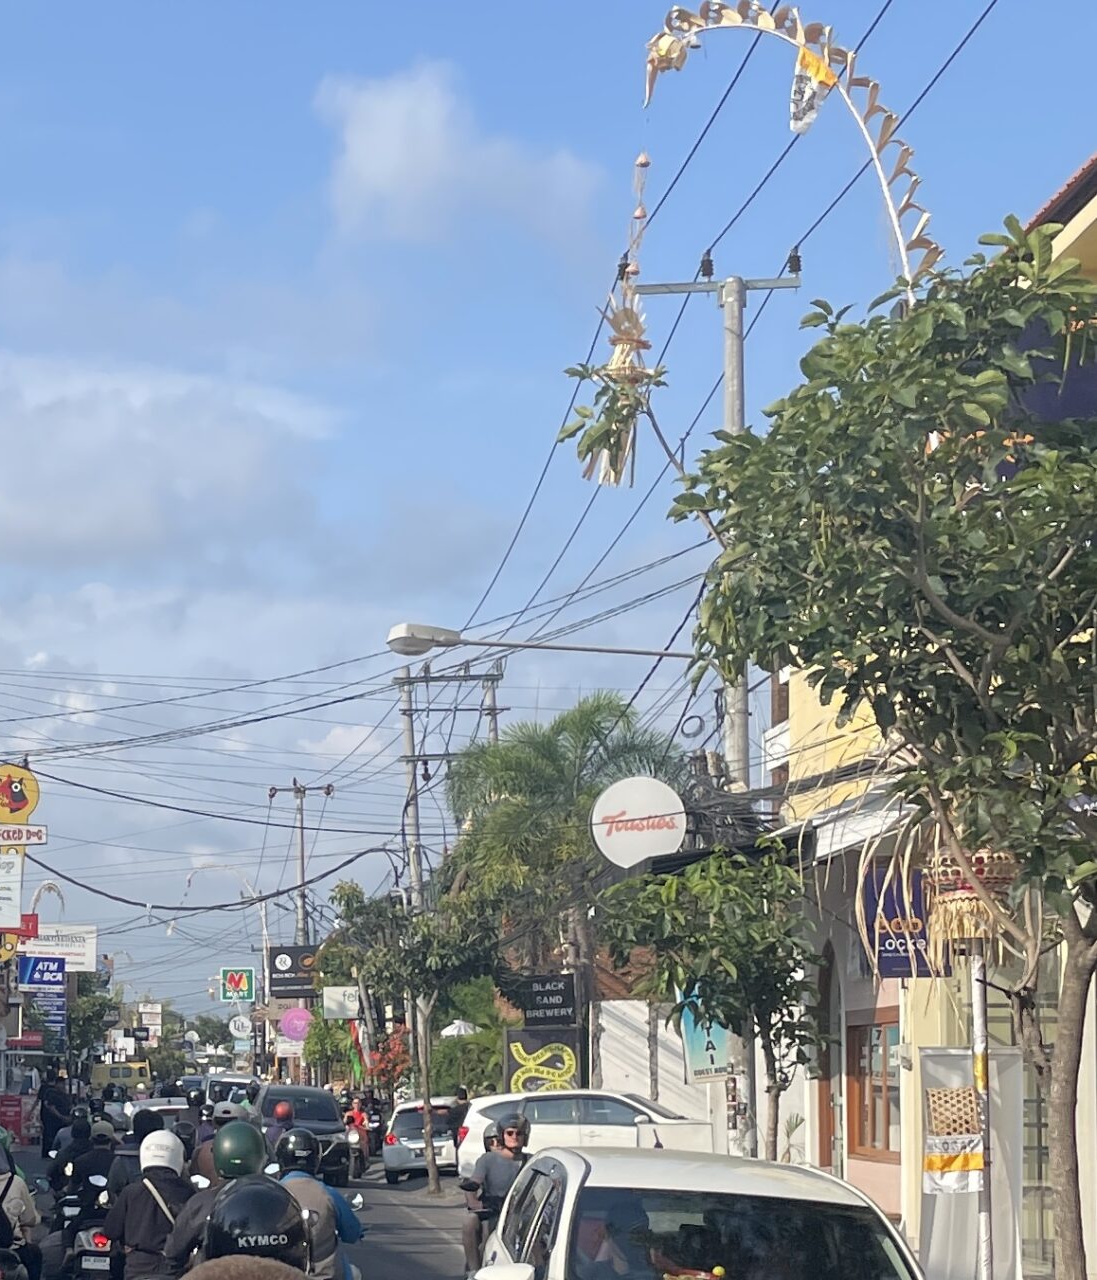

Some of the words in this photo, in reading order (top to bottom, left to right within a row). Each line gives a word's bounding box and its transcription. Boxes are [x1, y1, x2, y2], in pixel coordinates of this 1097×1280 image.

[36, 961, 59, 971] ATM
[42, 972, 63, 981] BCA
[532, 982, 565, 991] BLACK
[536, 995, 563, 1005] SAND
[526, 1007, 574, 1018] BREWERY
[237, 1234, 288, 1248] KYMCO
